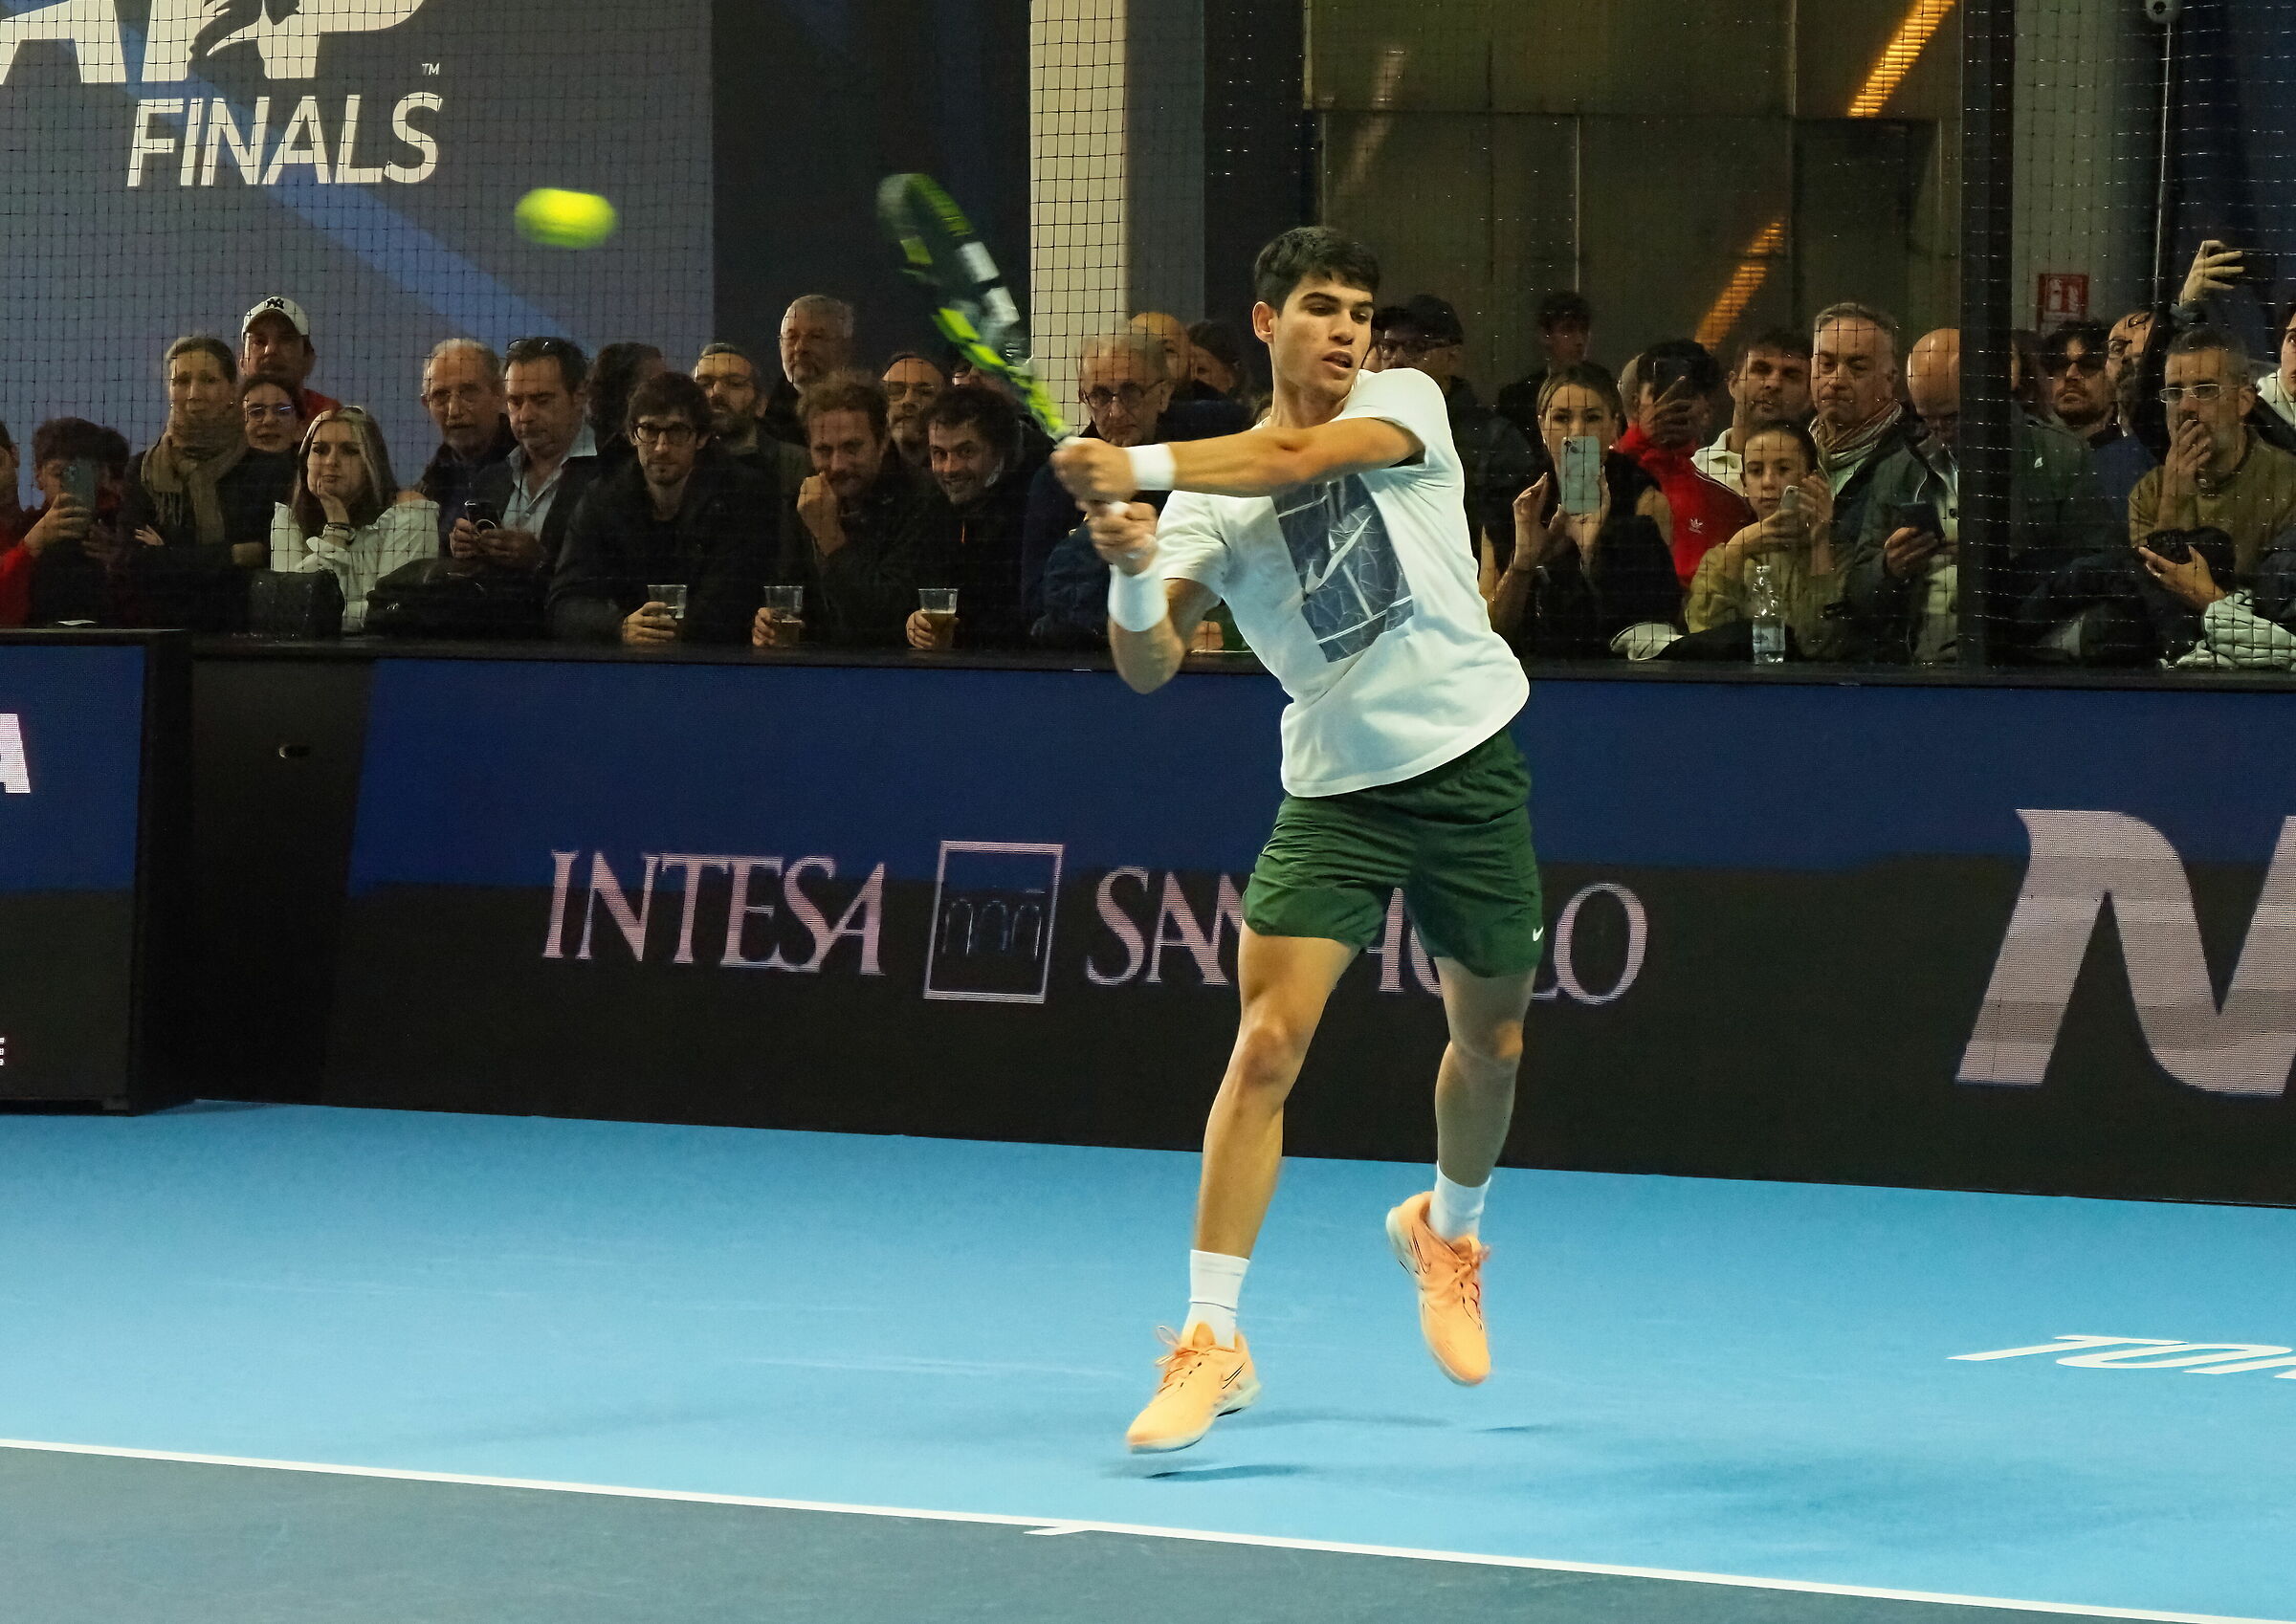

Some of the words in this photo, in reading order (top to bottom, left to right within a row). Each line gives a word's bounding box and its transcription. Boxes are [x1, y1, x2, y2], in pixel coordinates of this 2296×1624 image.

[421, 62, 440, 76] TM
[127, 92, 444, 187] FINALS
[541, 850, 886, 977] INTESA
